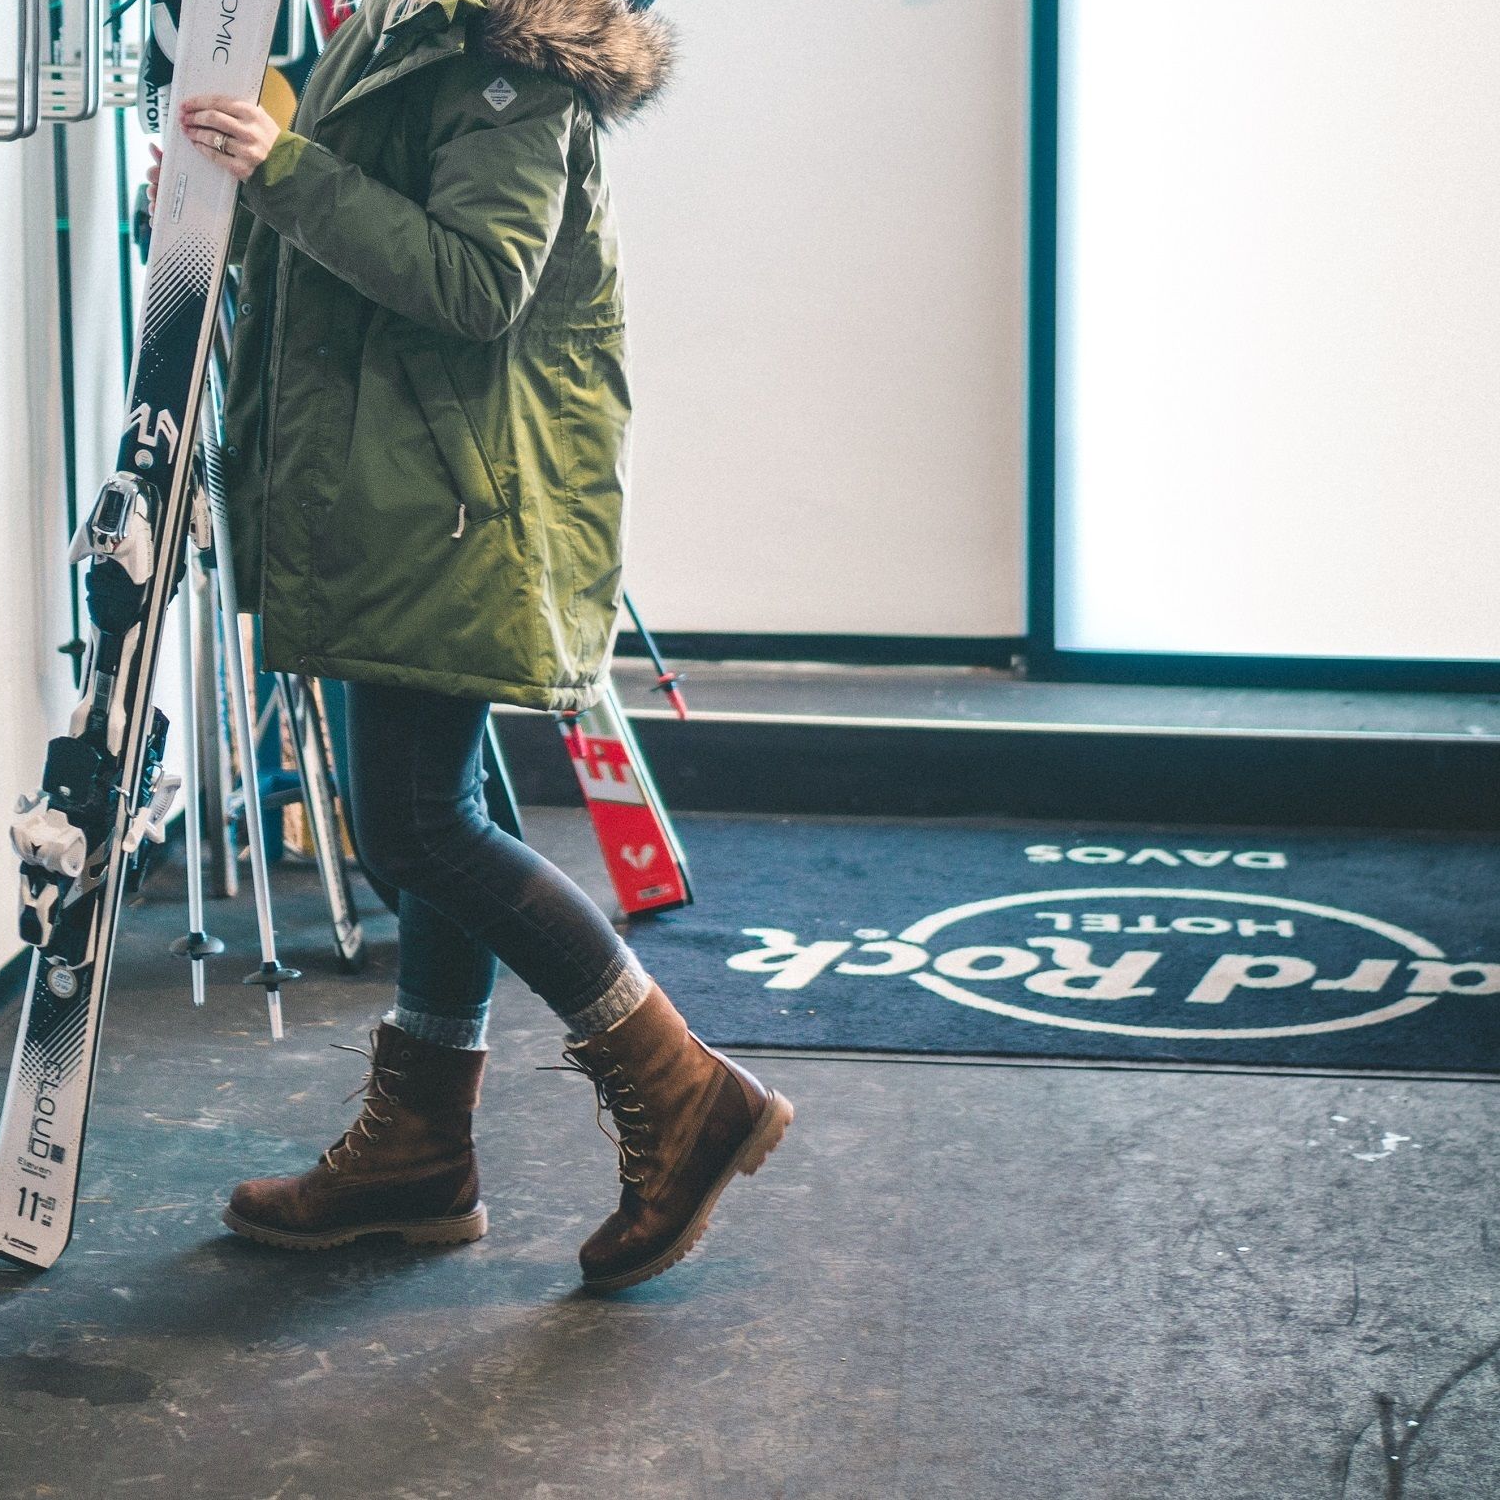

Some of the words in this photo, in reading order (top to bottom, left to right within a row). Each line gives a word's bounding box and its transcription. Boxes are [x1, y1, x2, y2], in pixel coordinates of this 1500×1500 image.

[1024, 844, 1287, 870] DAVOS
[1035, 912, 1296, 938] HOTEL
[726, 927, 1163, 1001] Rock
[30, 1060, 61, 1158] CLOUD
[18, 1187, 40, 1221] 11
